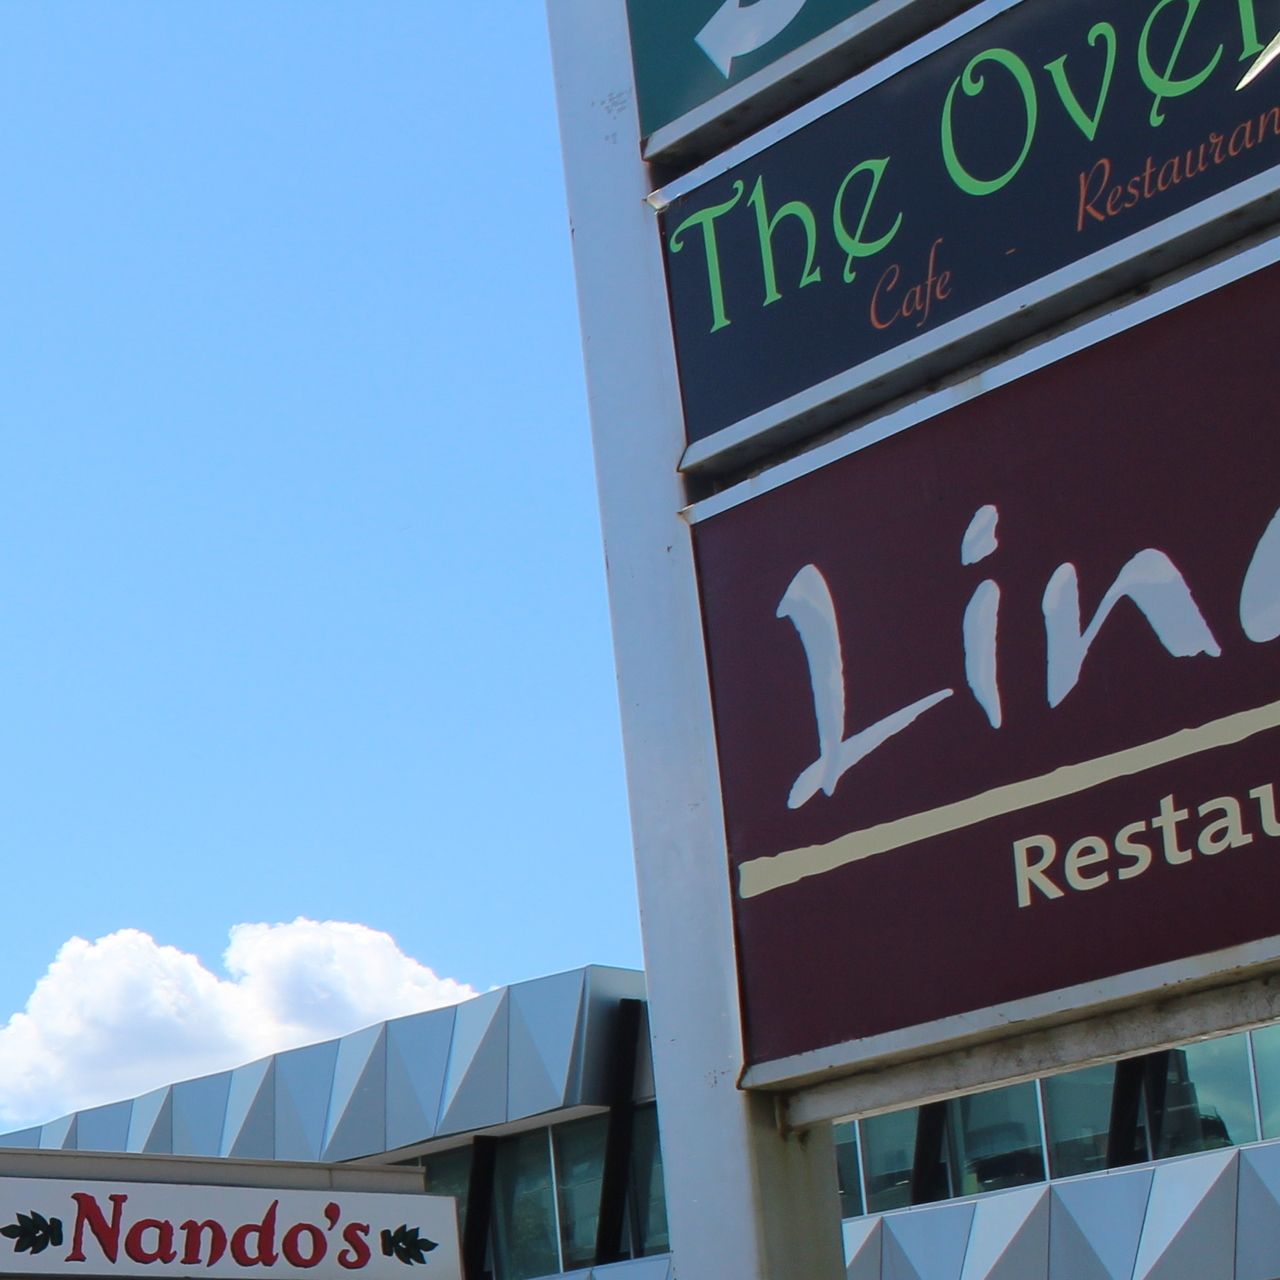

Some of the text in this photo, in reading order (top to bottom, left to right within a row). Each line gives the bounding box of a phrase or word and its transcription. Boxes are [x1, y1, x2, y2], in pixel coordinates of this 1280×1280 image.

[670, 156, 903, 334] The
[869, 236, 954, 330] Cafe
[64, 1191, 371, 1270] Nando's
